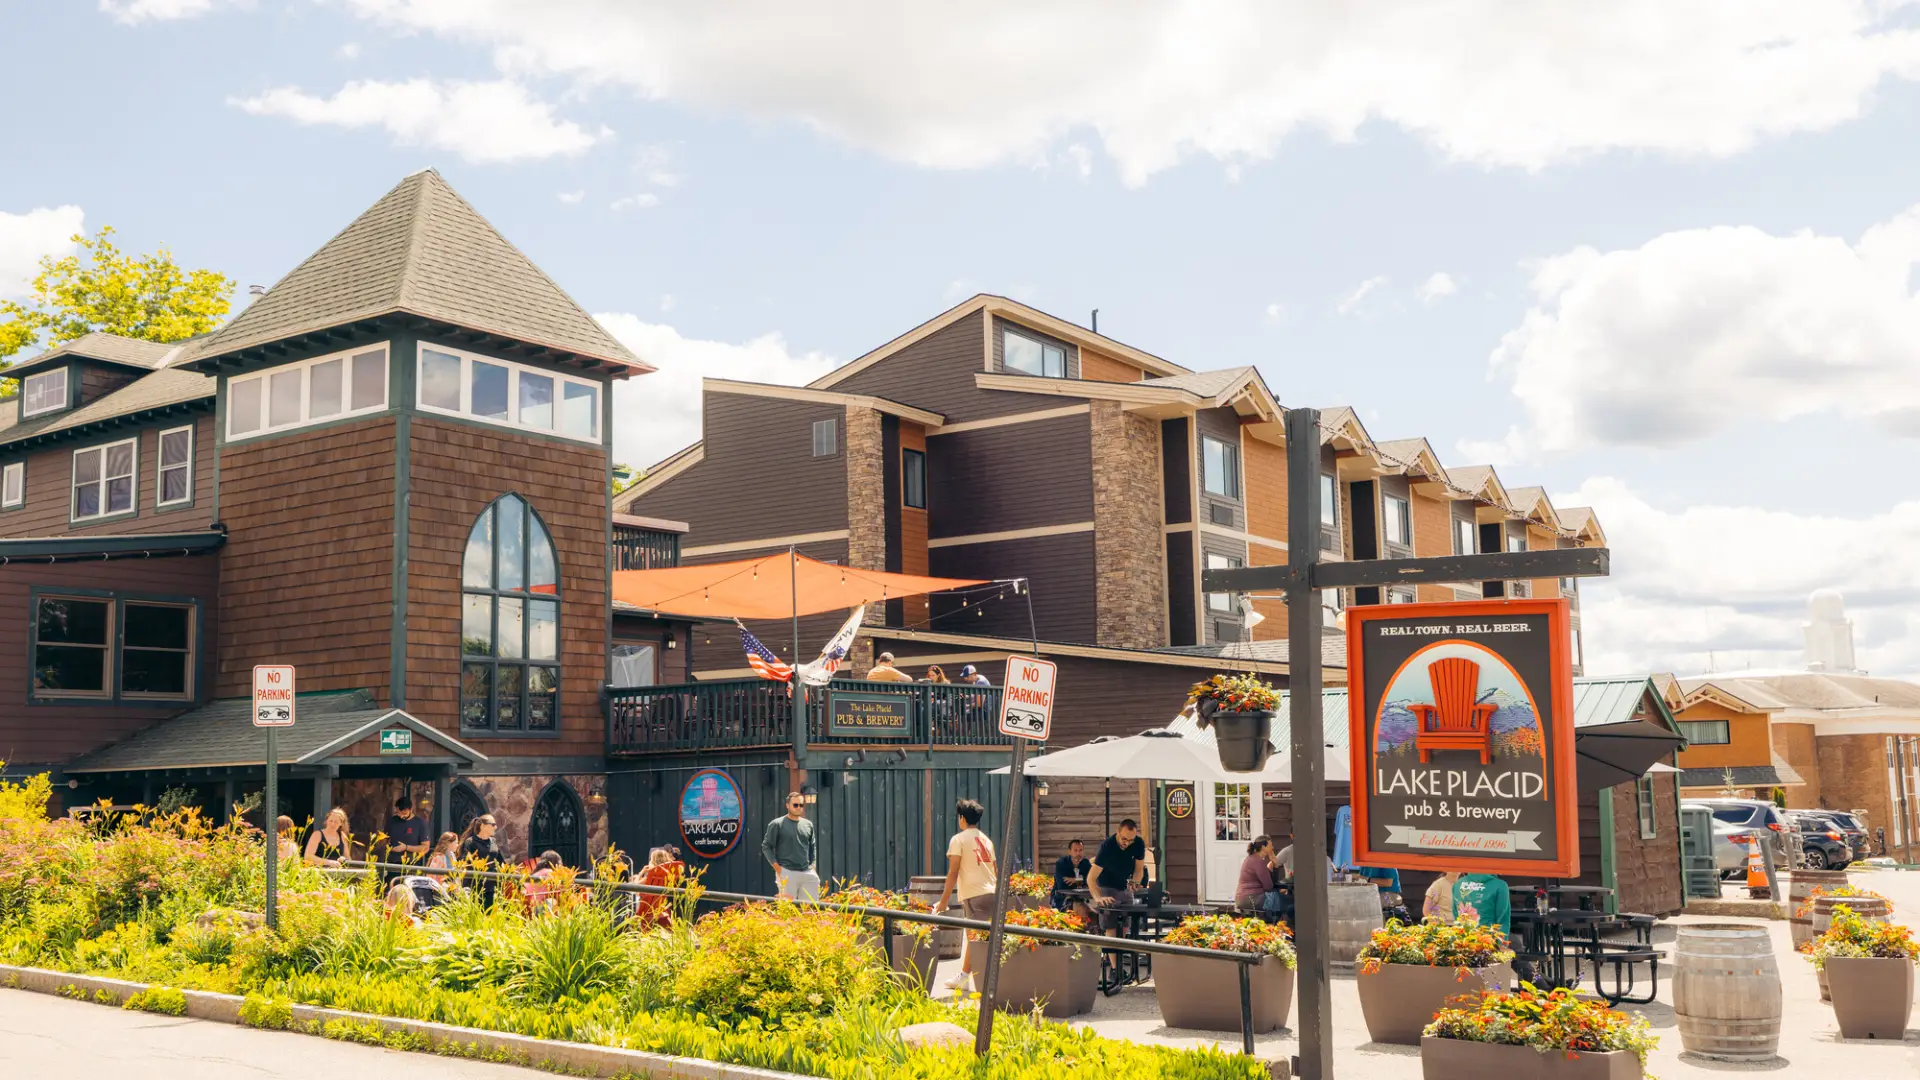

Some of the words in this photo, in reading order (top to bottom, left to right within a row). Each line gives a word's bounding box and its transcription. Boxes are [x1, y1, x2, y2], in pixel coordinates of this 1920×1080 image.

[1380, 626, 1415, 636] REAL
[1415, 625, 1453, 635] TOWN.
[1455, 624, 1492, 634] REAL
[1493, 623, 1532, 633] BEER.
[267, 672, 281, 683] NO
[1022, 666, 1039, 683] NO
[257, 689, 291, 700] PARKING
[1008, 686, 1049, 707] PARKING
[850, 703, 861, 711] The
[862, 703, 875, 712] Lake
[875, 704, 892, 713] Placid
[836, 713, 854, 725] PUB
[856, 714, 864, 725] &
[866, 715, 905, 726] BREWERY
[1378, 768, 1443, 796] LAKE
[1447, 770, 1544, 799] PLACID
[1404, 800, 1433, 820] pub
[1438, 801, 1452, 817] &
[1456, 801, 1522, 824] brewery
[684, 823, 706, 835] LAKE
[706, 822, 738, 834] PLACID
[706, 838, 728, 847] brewing
[1419, 832, 1482, 849] Established
[1483, 837, 1508, 849] 1996
